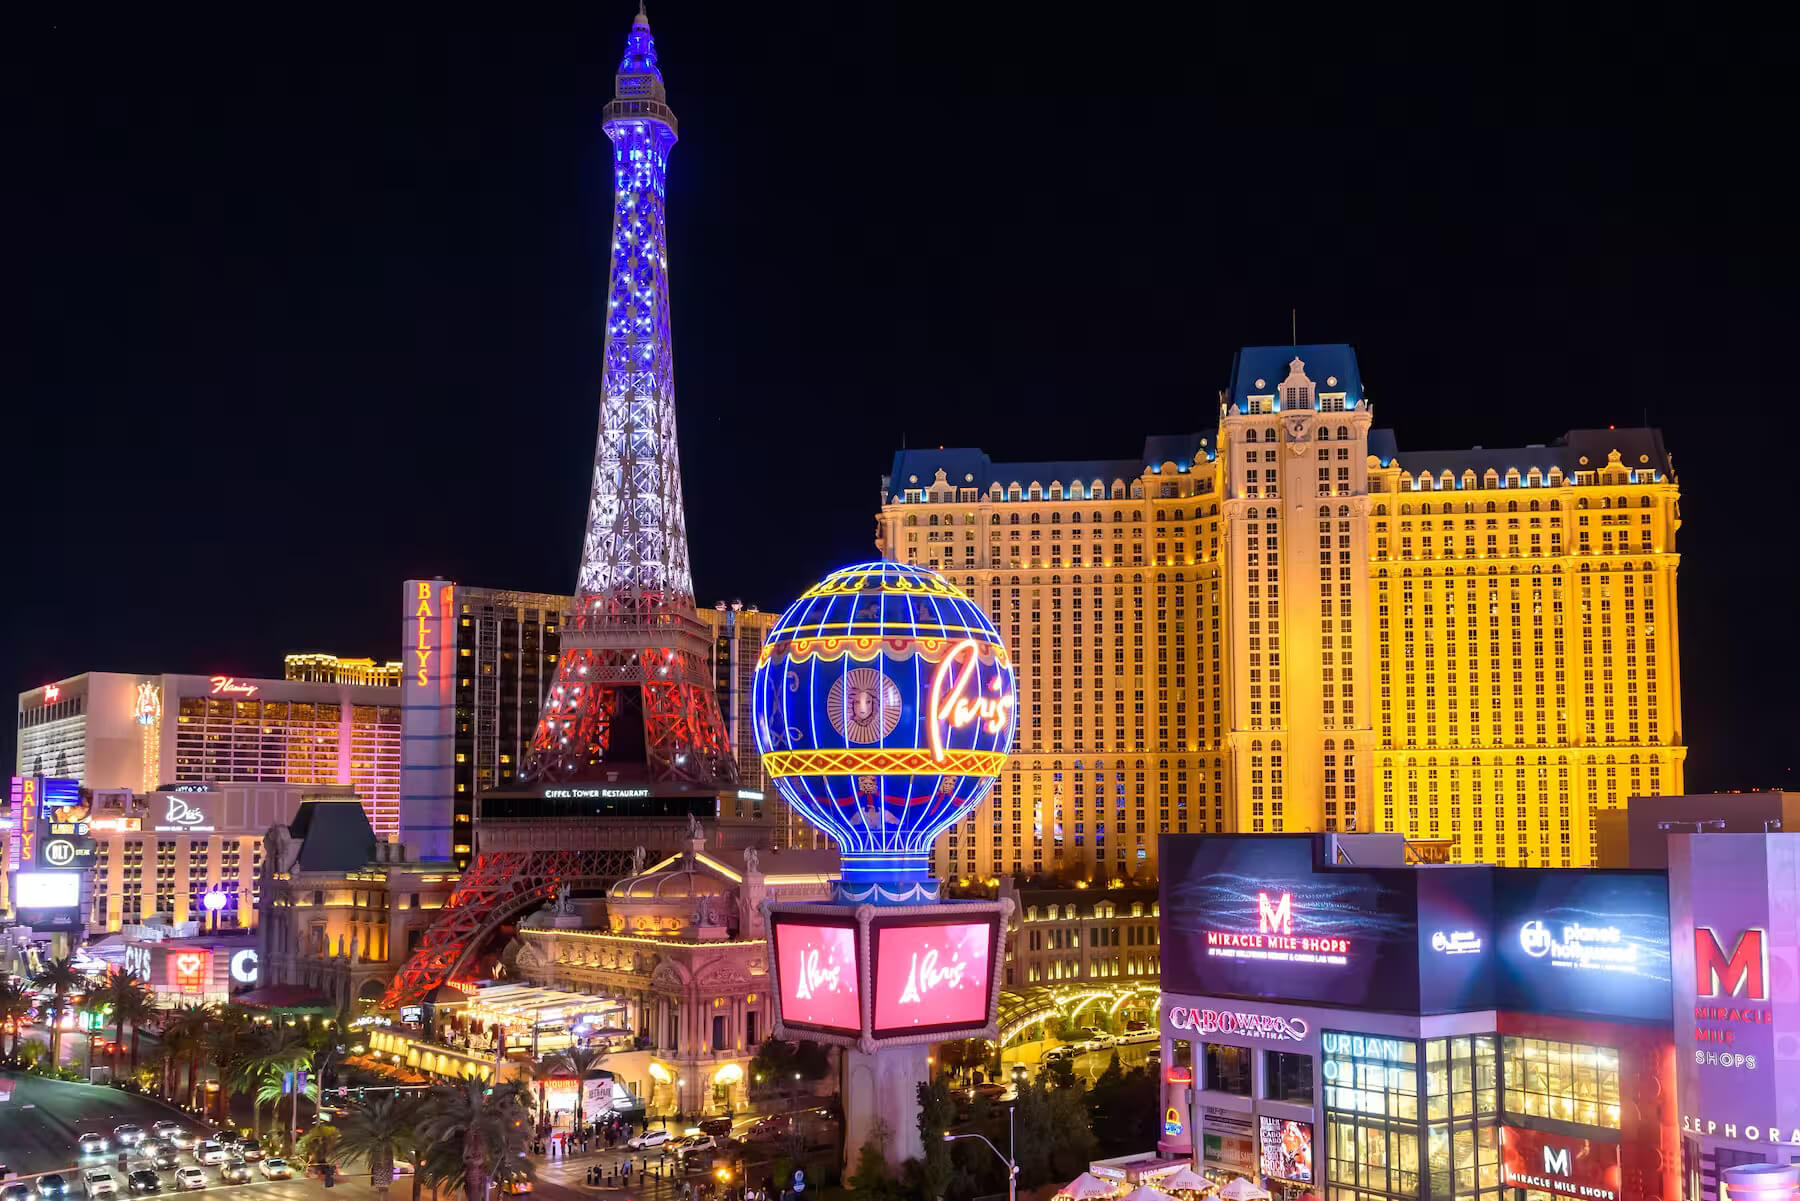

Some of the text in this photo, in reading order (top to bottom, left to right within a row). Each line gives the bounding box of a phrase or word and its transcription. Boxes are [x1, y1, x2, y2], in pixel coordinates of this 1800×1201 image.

[415, 582, 432, 687] BALLYS
[928, 637, 1015, 763] Paris
[545, 789, 648, 798] EIFFEL TOWER RESTAURANT
[1259, 892, 1291, 935] M
[1208, 931, 1263, 947] MIRACLE
[1267, 936, 1297, 949] MILE
[807, 949, 841, 992] Paris
[919, 948, 968, 993] Paris
[1169, 1006, 1288, 1036] CABO WABO
[1695, 1007, 1772, 1025] MIRACLE
[1240, 1030, 1284, 1041] CANTINA
[1323, 1032, 1398, 1062] URBAN
[1695, 1028, 1735, 1044] MILE
[1695, 1051, 1757, 1070] SHOPS
[1544, 1145, 1573, 1176] M
[1508, 1171, 1614, 1201] MIRACLE MILE SHOPS
